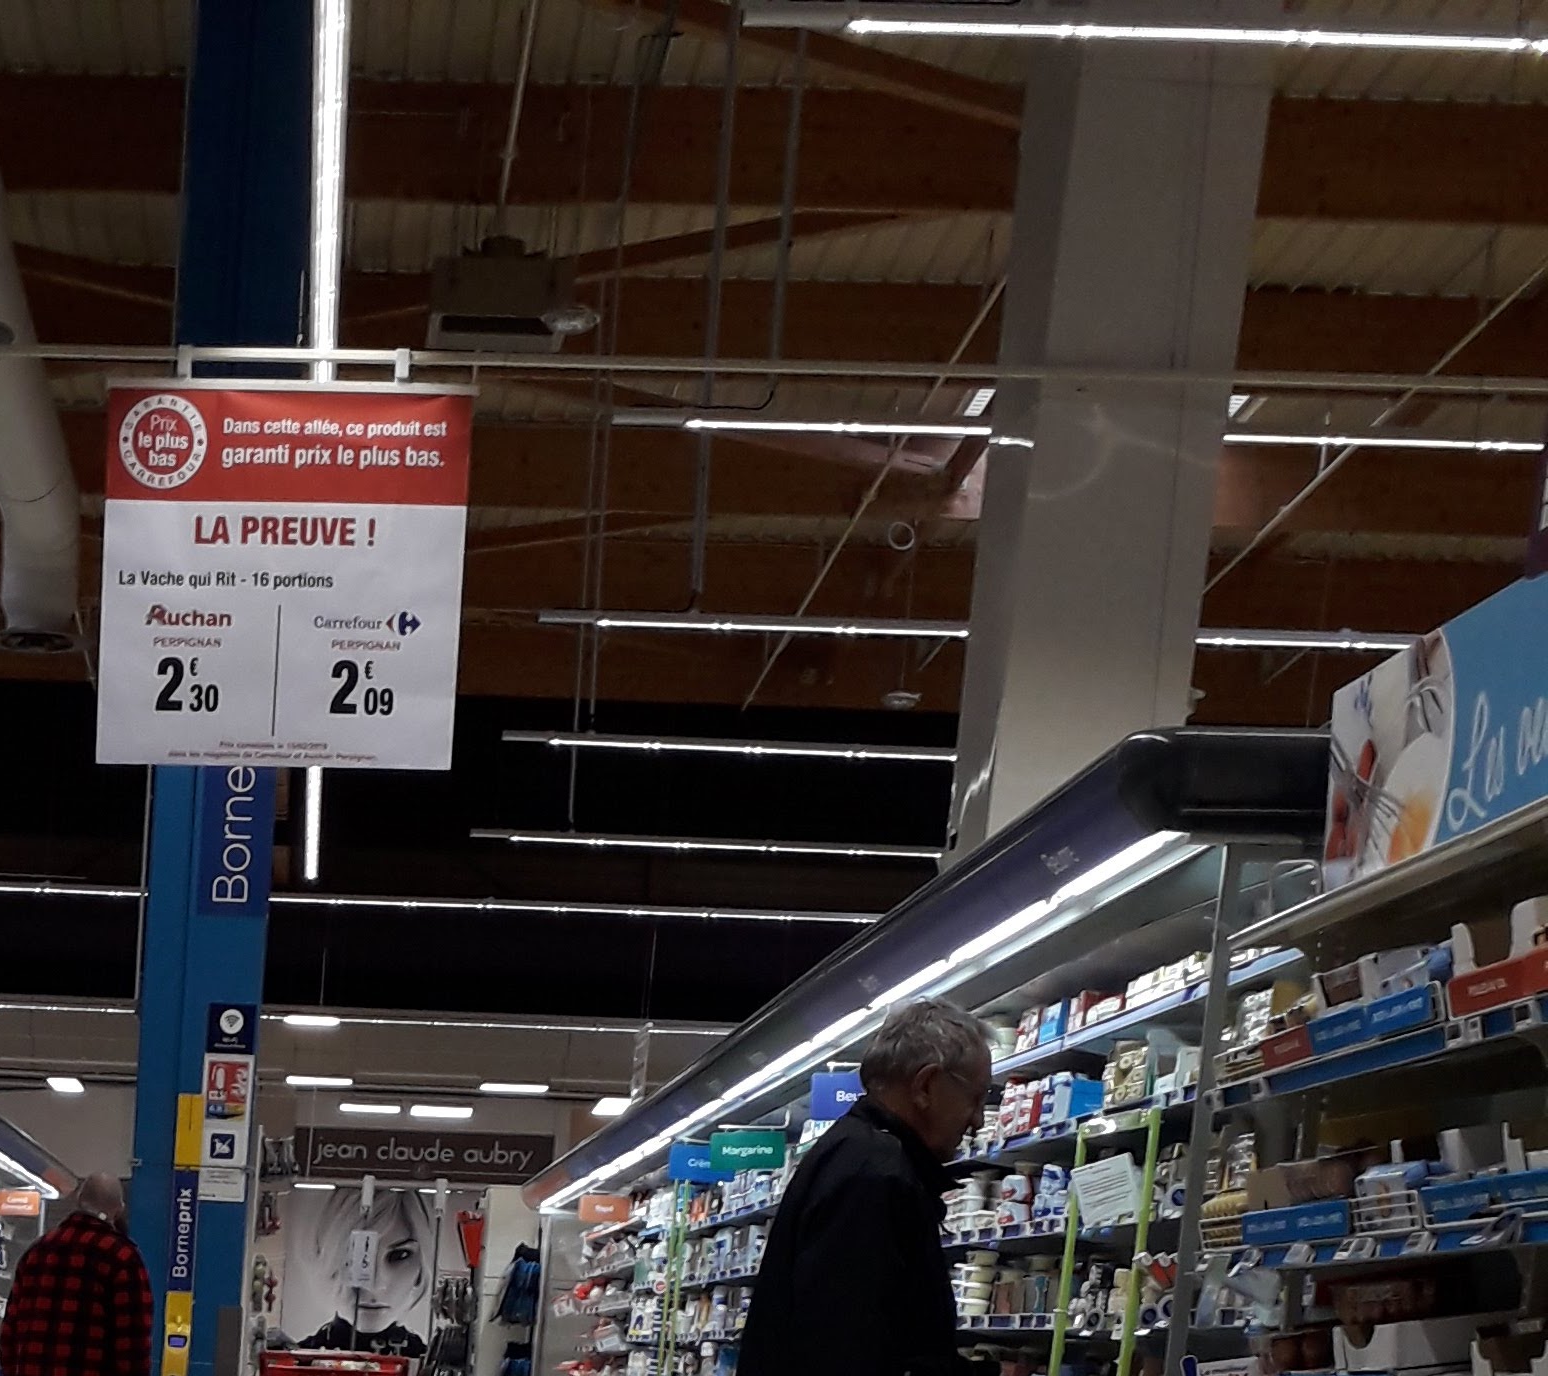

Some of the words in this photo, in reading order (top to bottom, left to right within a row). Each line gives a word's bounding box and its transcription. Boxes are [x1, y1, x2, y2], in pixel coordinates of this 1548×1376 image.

[222, 417, 261, 435] Dans
[263, 418, 301, 436] cette
[345, 422, 364, 437] ce
[366, 420, 421, 440] produit
[423, 421, 447, 438] est
[137, 431, 153, 449] le
[155, 431, 190, 452] plus
[148, 449, 177, 467] bas
[221, 443, 291, 470] garanti
[294, 444, 333, 470] prix
[336, 444, 354, 466] le
[358, 445, 401, 471] plus
[404, 445, 446, 469] bas.
[194, 515, 230, 546] LA
[240, 515, 357, 547] PREUVE
[118, 570, 136, 586] La
[140, 570, 184, 587] Vache
[188, 571, 211, 590] qui
[215, 571, 236, 587] Rit
[251, 572, 270, 588] 16
[272, 572, 334, 591] portions
[145, 604, 232, 627] Auchan
[313, 614, 383, 630] Carrefour
[152, 636, 222, 648] PERPIGNAN
[312, 1135, 368, 1166] jean
[376, 1136, 455, 1164] claude
[462, 1140, 534, 1172] aubry
[722, 1143, 774, 1158] Margarine
[171, 1187, 193, 1278] Borneprix
